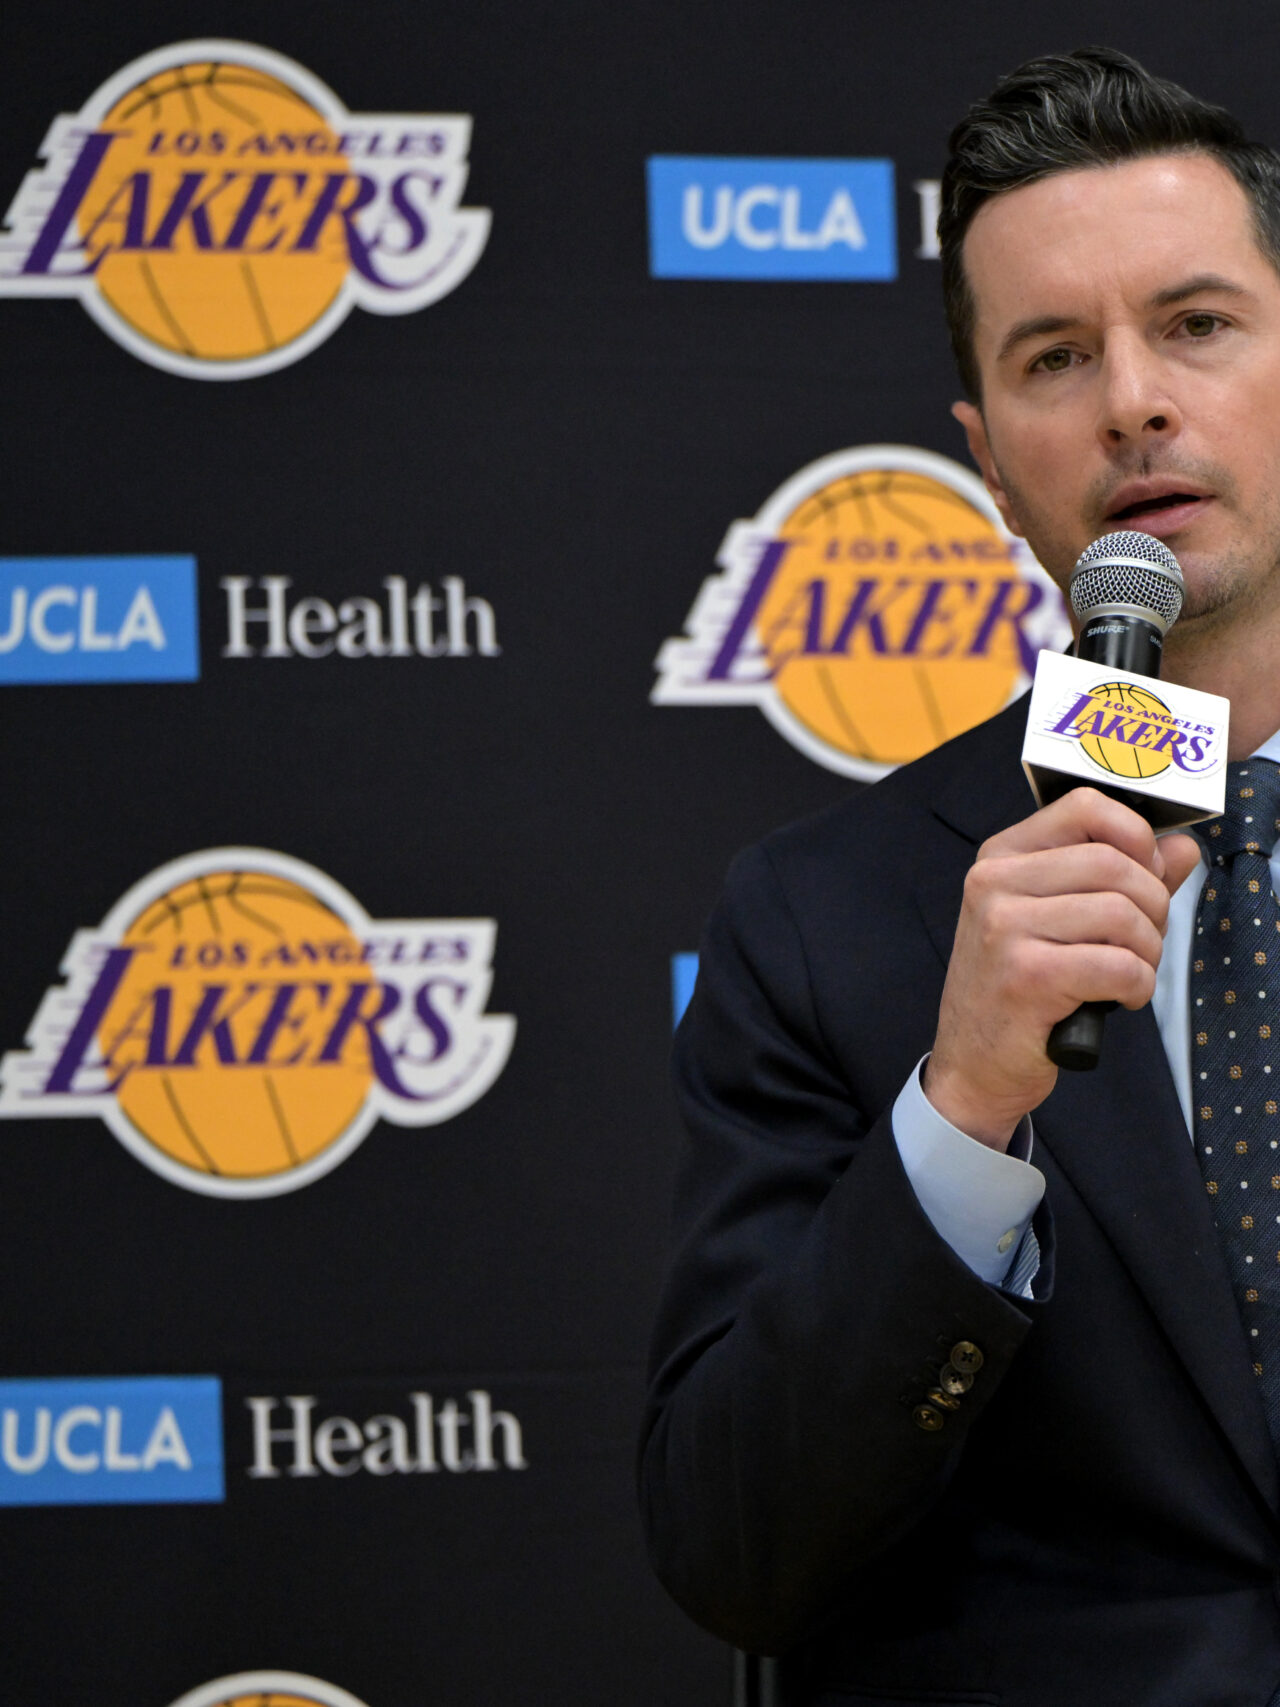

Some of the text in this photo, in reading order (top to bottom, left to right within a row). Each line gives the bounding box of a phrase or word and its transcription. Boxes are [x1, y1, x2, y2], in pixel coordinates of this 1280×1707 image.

[148, 130, 447, 157] LOS ANGELES
[12, 130, 466, 291] LAKERS
[682, 184, 867, 250] UCLA
[826, 537, 1030, 563] LOS ANGE
[221, 575, 502, 657] Health
[687, 537, 1069, 682] LAKER
[1087, 625, 1126, 638] SHURE
[1044, 692, 1218, 772] LAKERS
[1103, 700, 1215, 735] LOS ANGELES
[170, 937, 469, 969] LOS ANGELES
[22, 943, 490, 1101] LAKERS
[3, 1390, 528, 1477] UCLA Health
